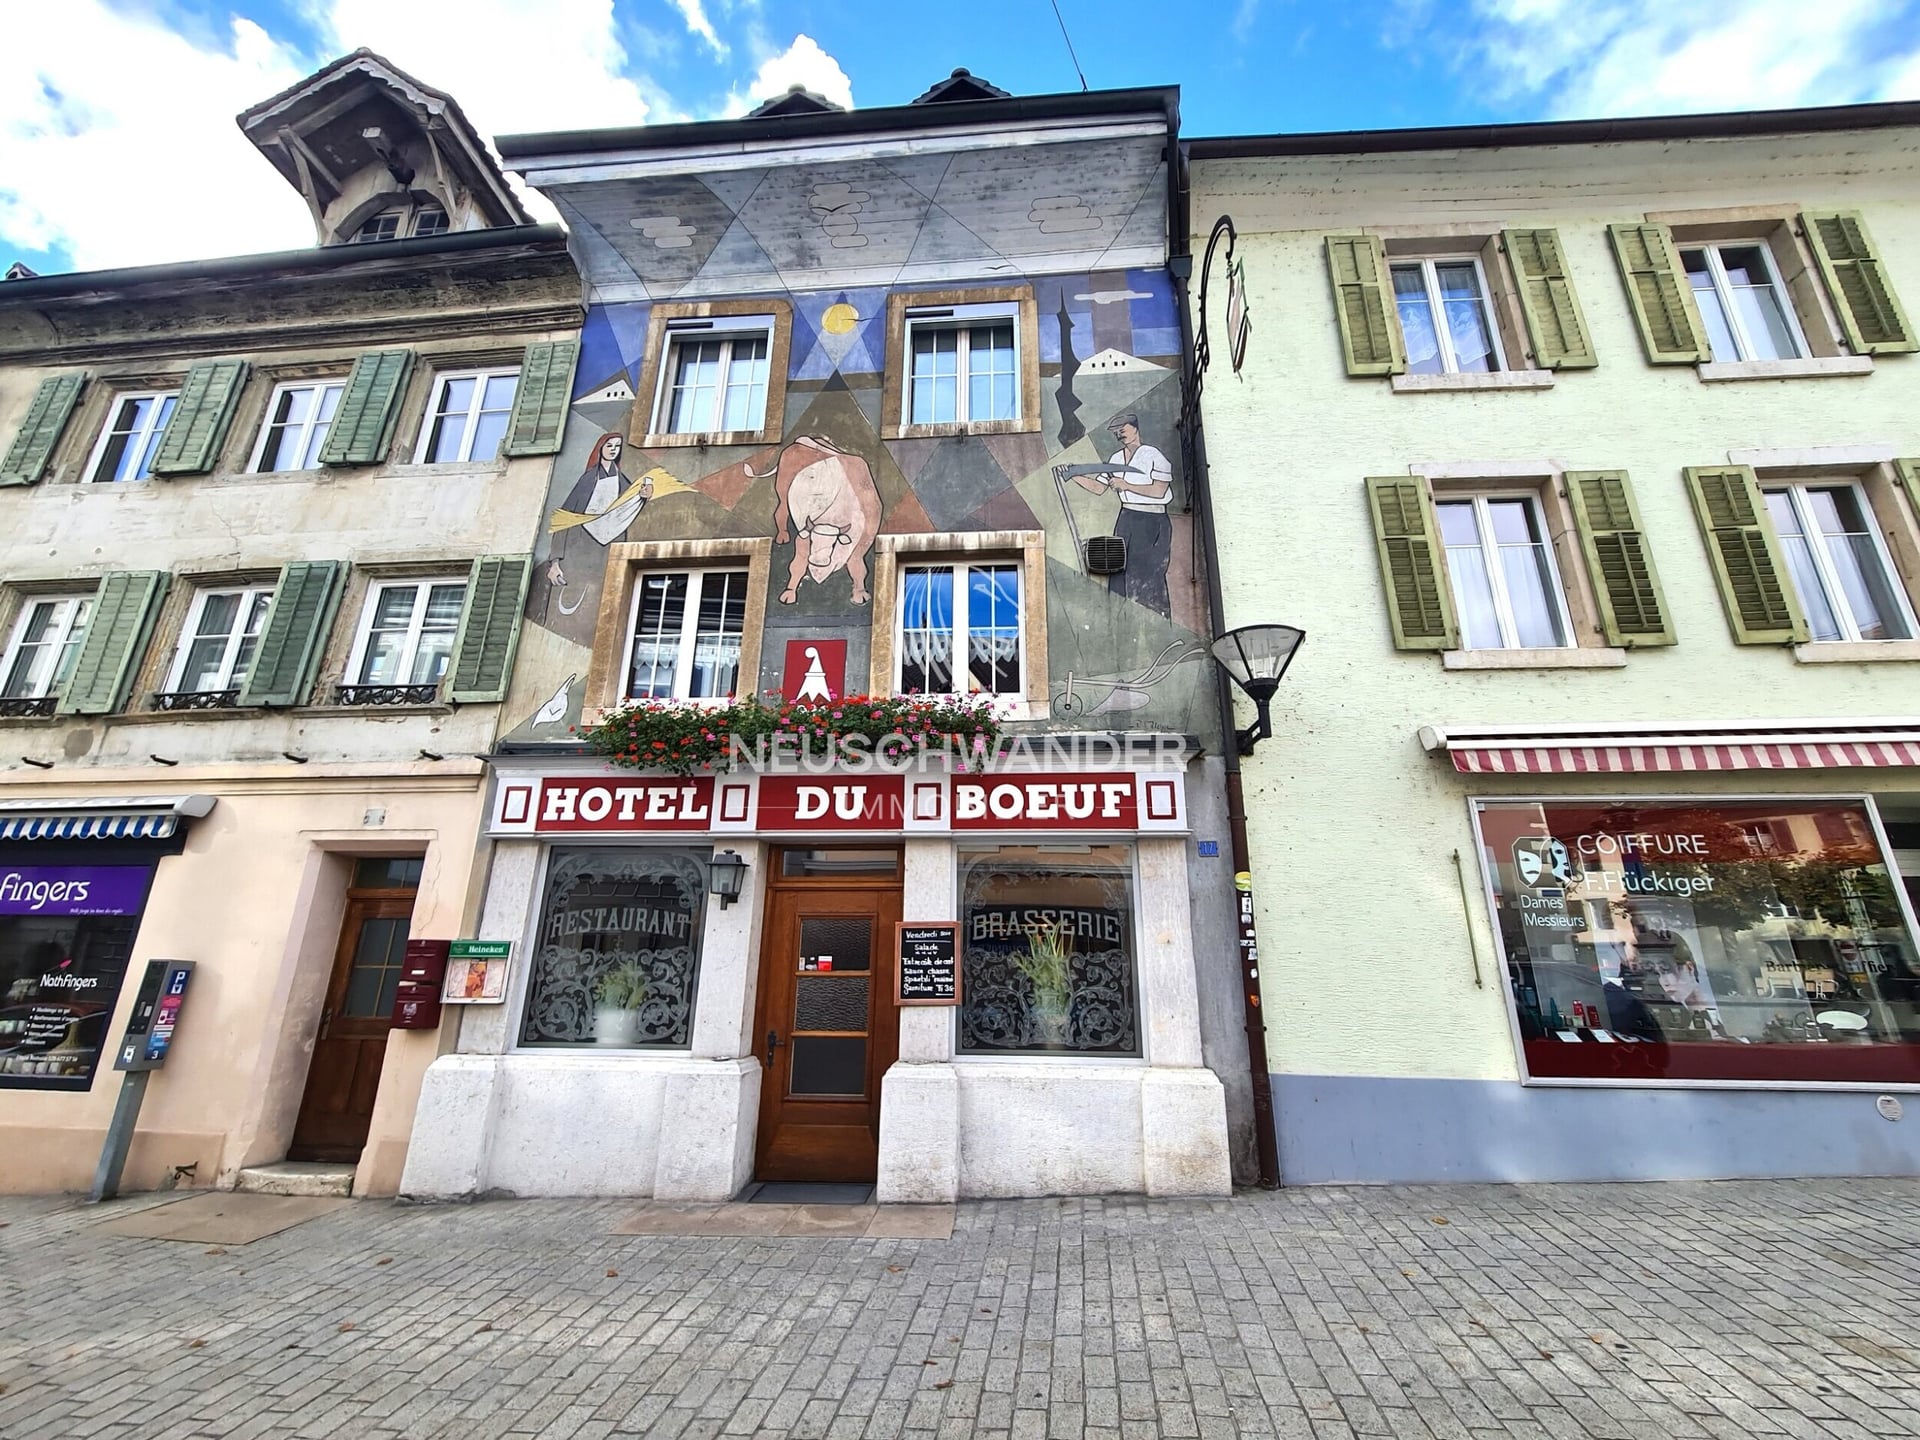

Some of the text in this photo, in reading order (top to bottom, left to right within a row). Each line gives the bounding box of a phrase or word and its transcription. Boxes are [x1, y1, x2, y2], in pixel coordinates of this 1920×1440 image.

[542, 783, 1132, 821] HOTEL DU BOEUF
[1577, 834, 1710, 855] COIFFURE
[0, 873, 91, 910] fingers
[1584, 870, 1715, 897] F.Flückiger
[1521, 895, 1563, 909] Dames
[550, 907, 690, 939] RESTAURANT
[972, 910, 1120, 943] BRASSERIE
[1523, 913, 1585, 927] Messieurs
[468, 945, 504, 953] Heineken
[40, 974, 98, 991] Nathfingers
[175, 971, 186, 985] P
